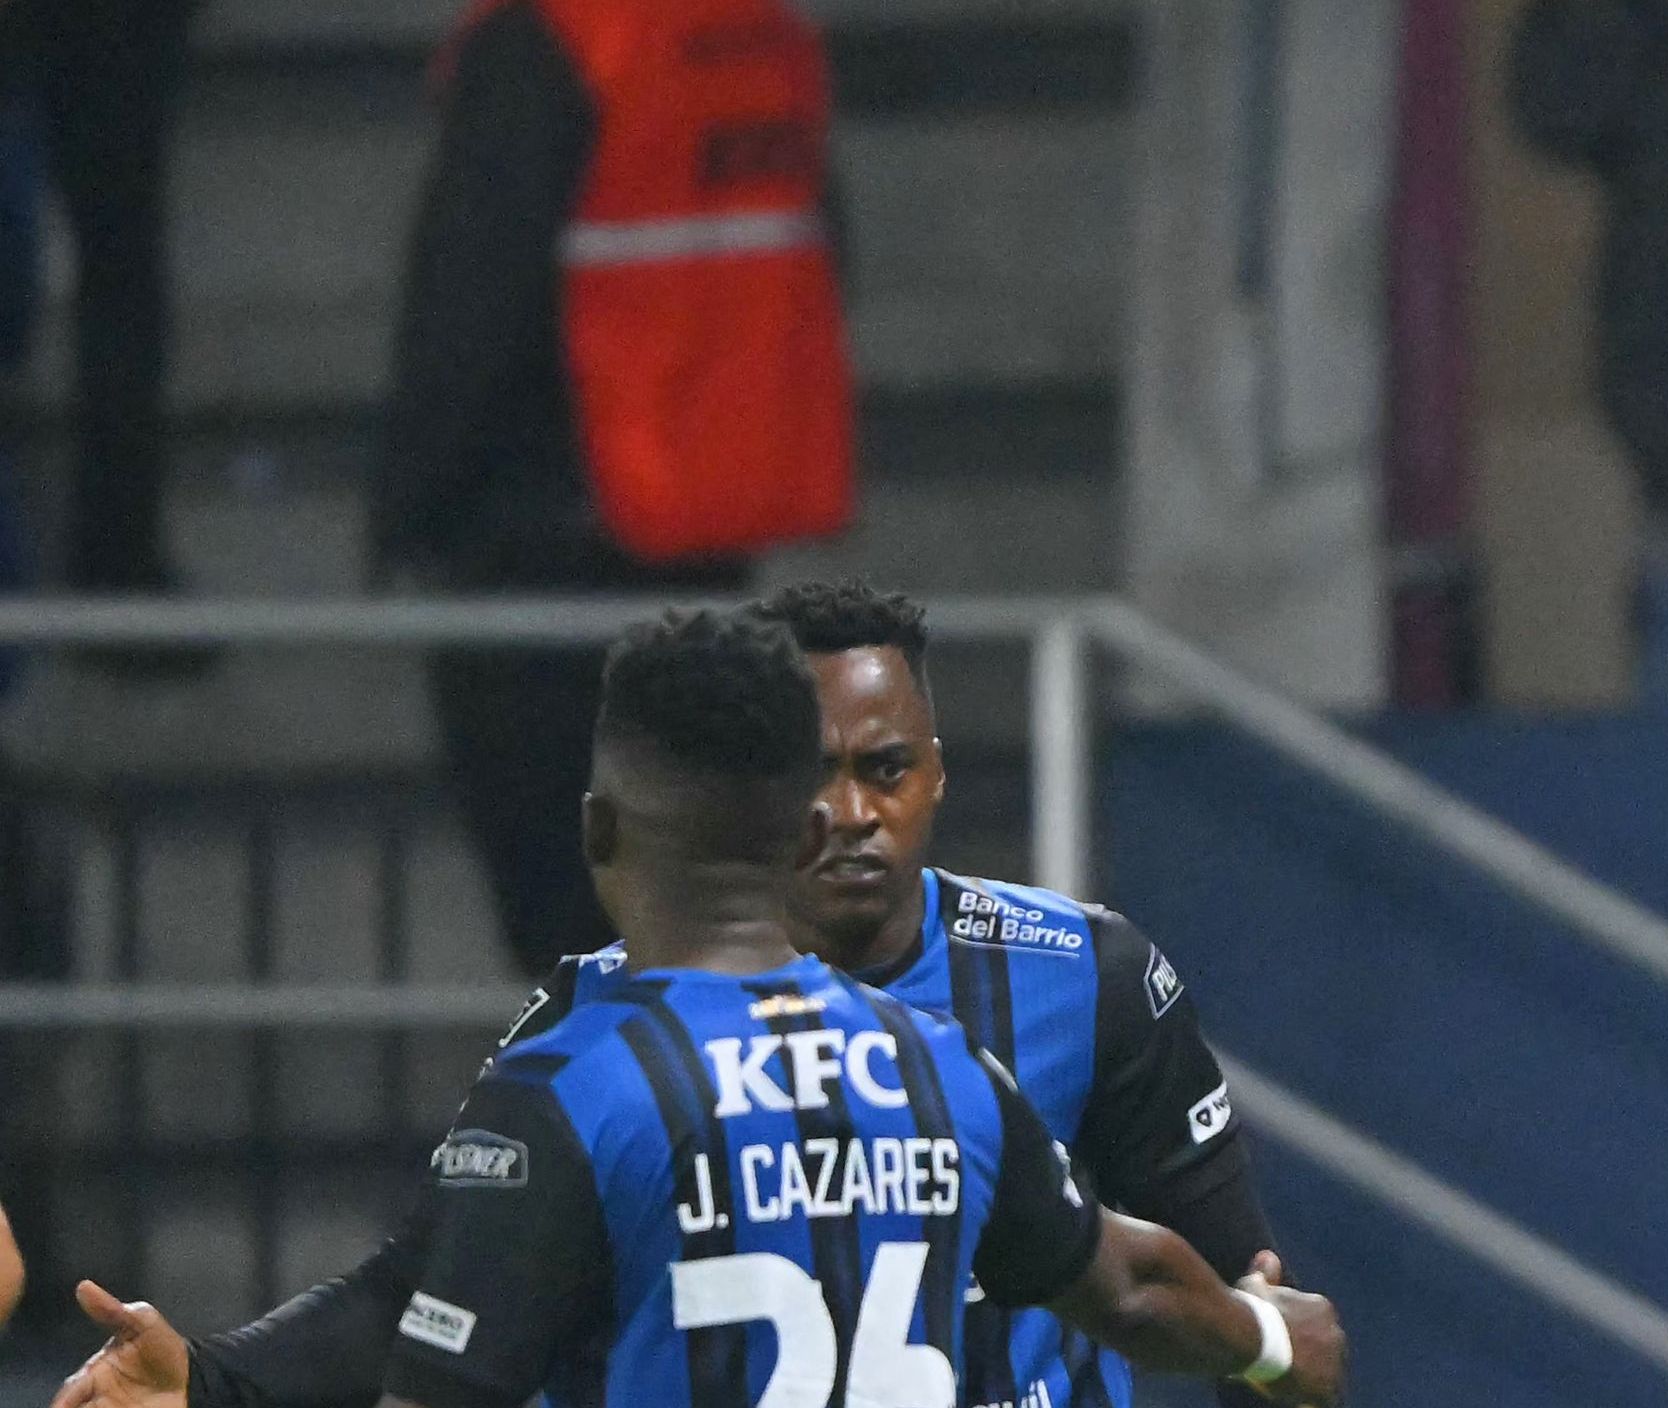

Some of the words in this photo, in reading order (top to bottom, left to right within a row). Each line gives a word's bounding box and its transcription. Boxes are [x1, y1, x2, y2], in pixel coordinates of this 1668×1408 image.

[953, 913, 994, 939] del
[1000, 918, 1083, 949] Barrio
[958, 891, 1044, 922] Banco
[704, 1028, 909, 1119] KFC
[679, 1152, 730, 1234] J.
[739, 1137, 960, 1223] CAZARES
